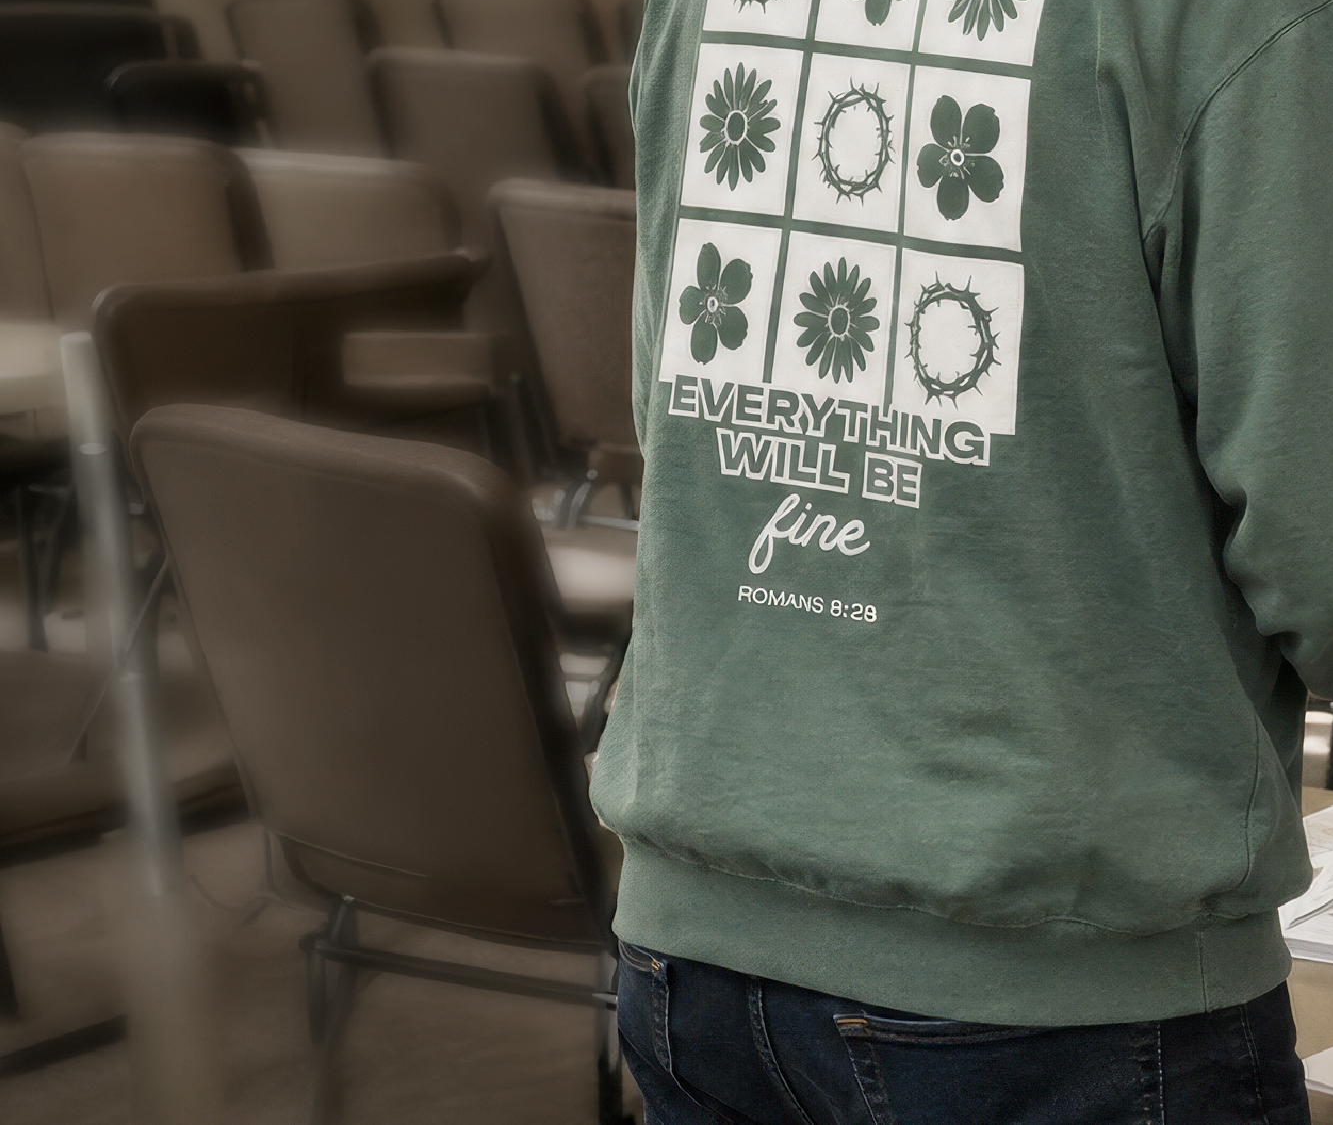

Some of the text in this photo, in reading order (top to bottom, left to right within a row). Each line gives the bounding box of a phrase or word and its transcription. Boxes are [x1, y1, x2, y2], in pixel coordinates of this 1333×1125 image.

[670, 376, 991, 466] EVERYTHING
[716, 428, 923, 508] WILL BE
[748, 493, 870, 574] fine
[738, 585, 878, 623] ROMANS 8:28
